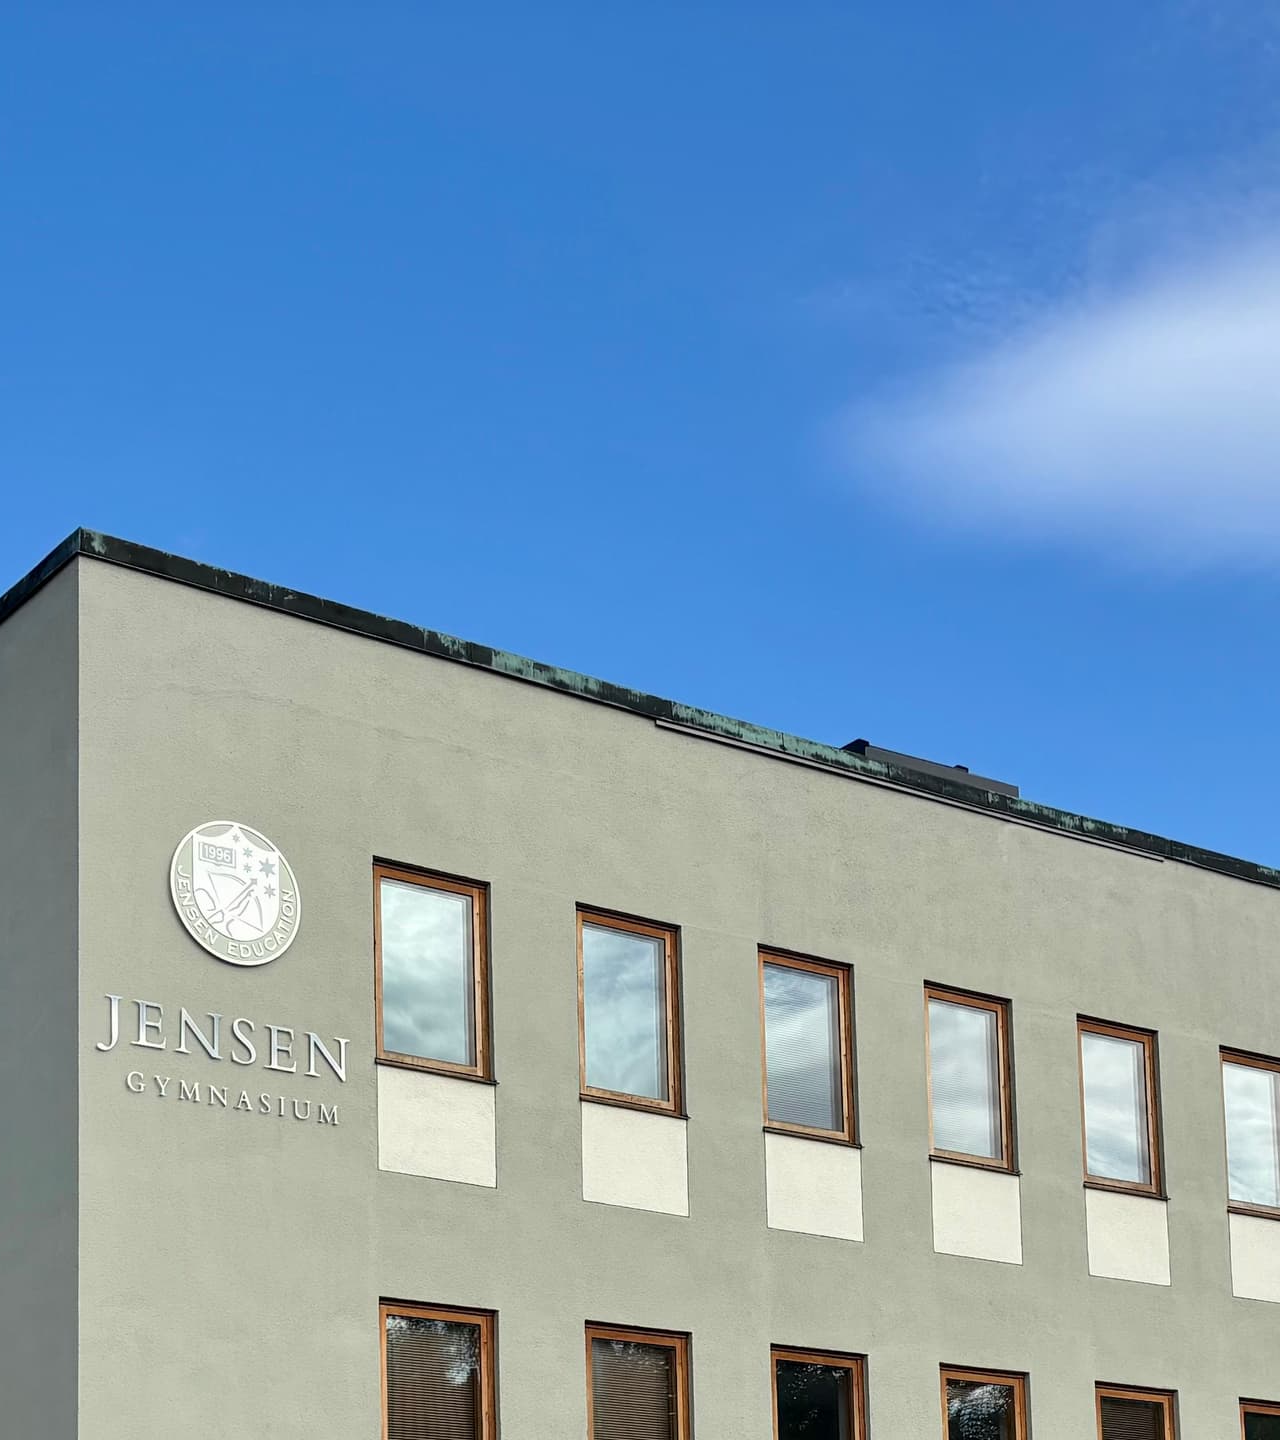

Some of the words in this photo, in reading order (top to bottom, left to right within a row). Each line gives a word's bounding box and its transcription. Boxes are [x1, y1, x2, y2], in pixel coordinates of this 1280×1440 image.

[204, 844, 232, 862] 1996
[177, 864, 219, 946] JENSEN
[227, 889, 294, 958] EDUCATION
[96, 993, 351, 1083] JENSEN
[125, 1070, 341, 1126] GYMNASIUM
